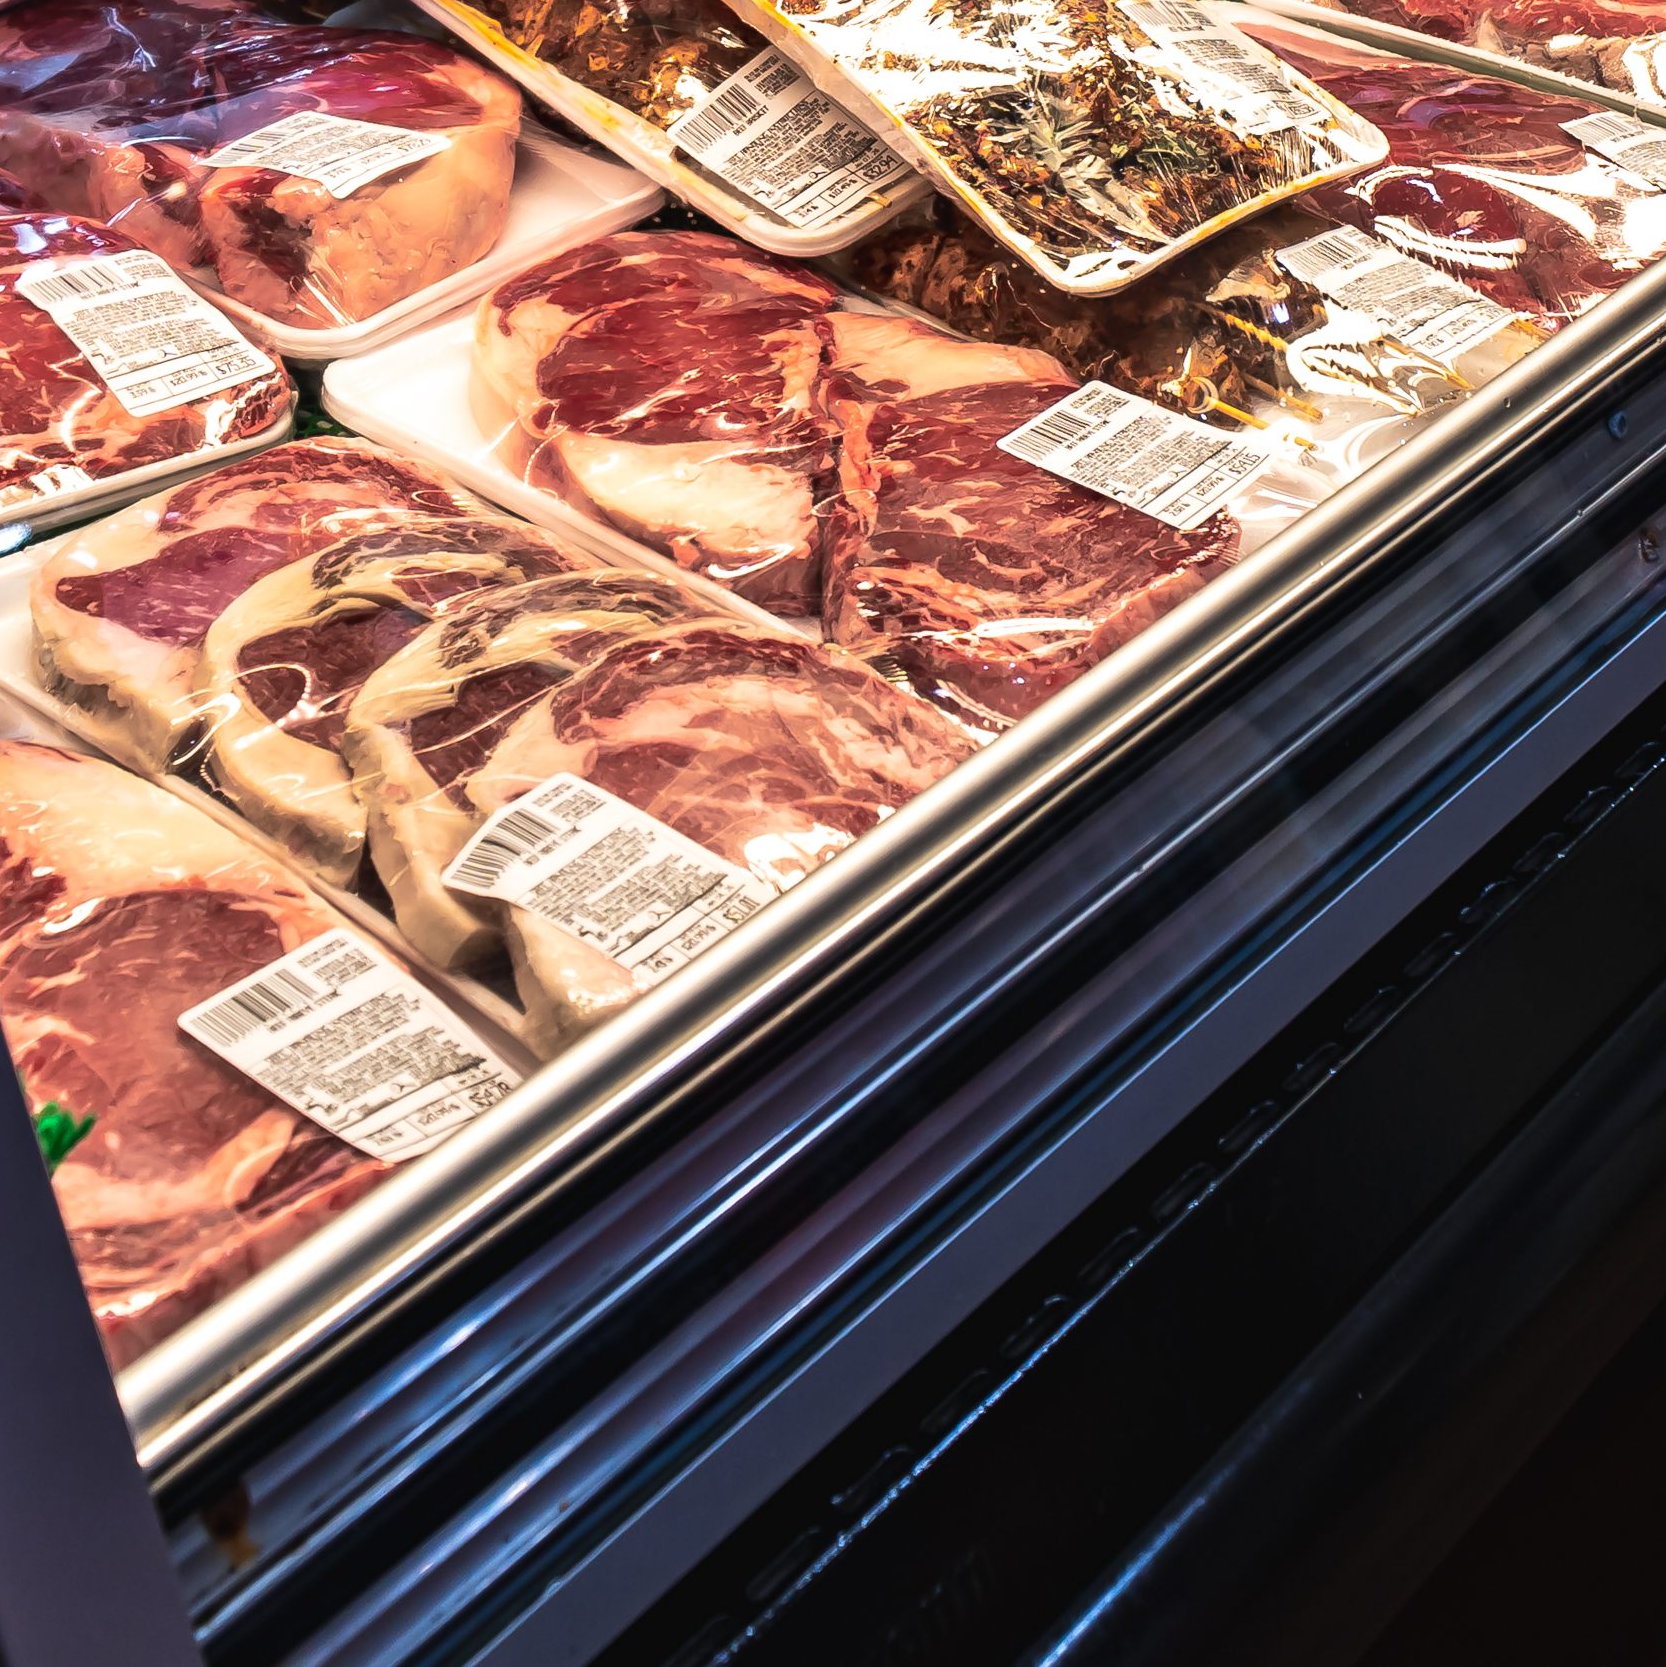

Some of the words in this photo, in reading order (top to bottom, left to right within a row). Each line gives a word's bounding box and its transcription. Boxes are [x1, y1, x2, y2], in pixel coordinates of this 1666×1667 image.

[746, 105, 770, 125] BRISKET
[862, 156, 898, 181] $32.94
[215, 356, 256, 376] $75.35
[1228, 453, 1261, 475] $54.15
